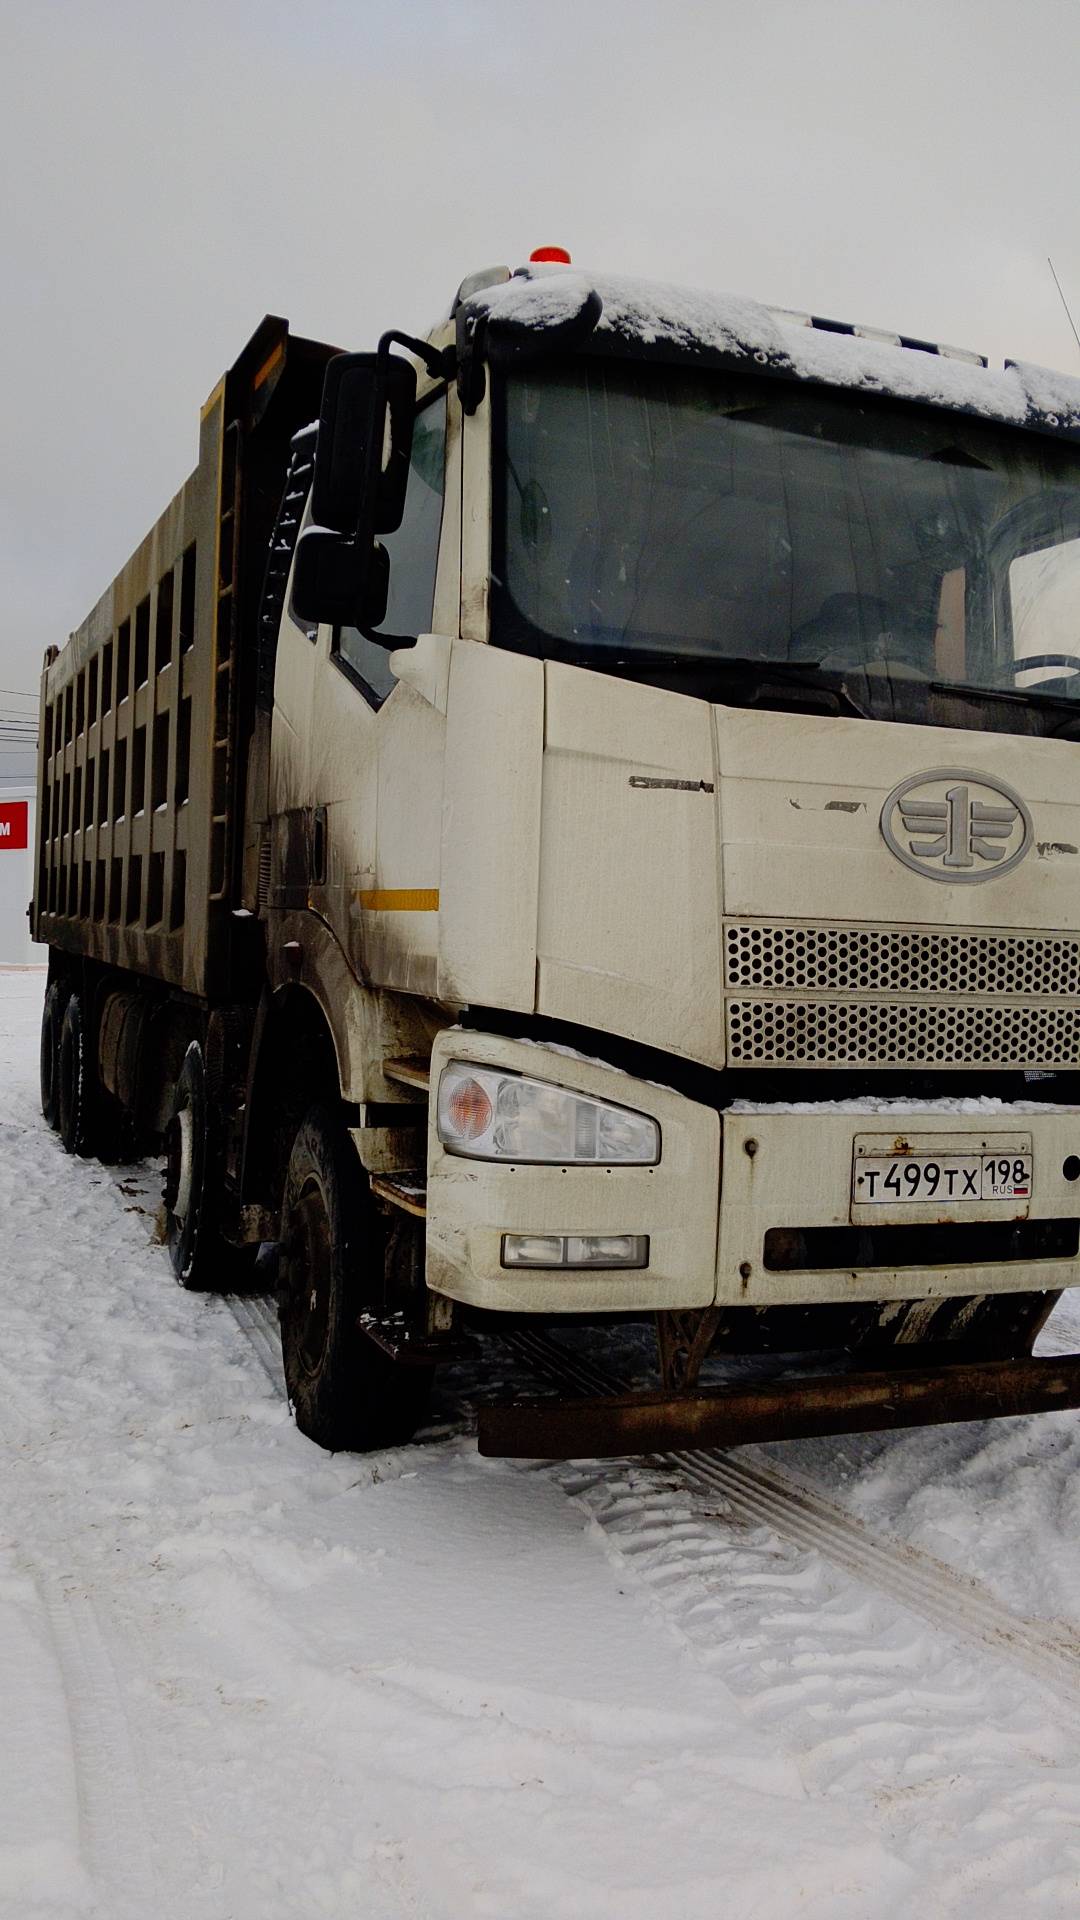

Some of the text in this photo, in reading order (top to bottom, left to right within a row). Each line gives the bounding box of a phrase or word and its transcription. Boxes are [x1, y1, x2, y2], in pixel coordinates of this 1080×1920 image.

[864, 1159, 1025, 1197] Т499ТХ 198
[992, 1185, 1013, 1194] RUS
